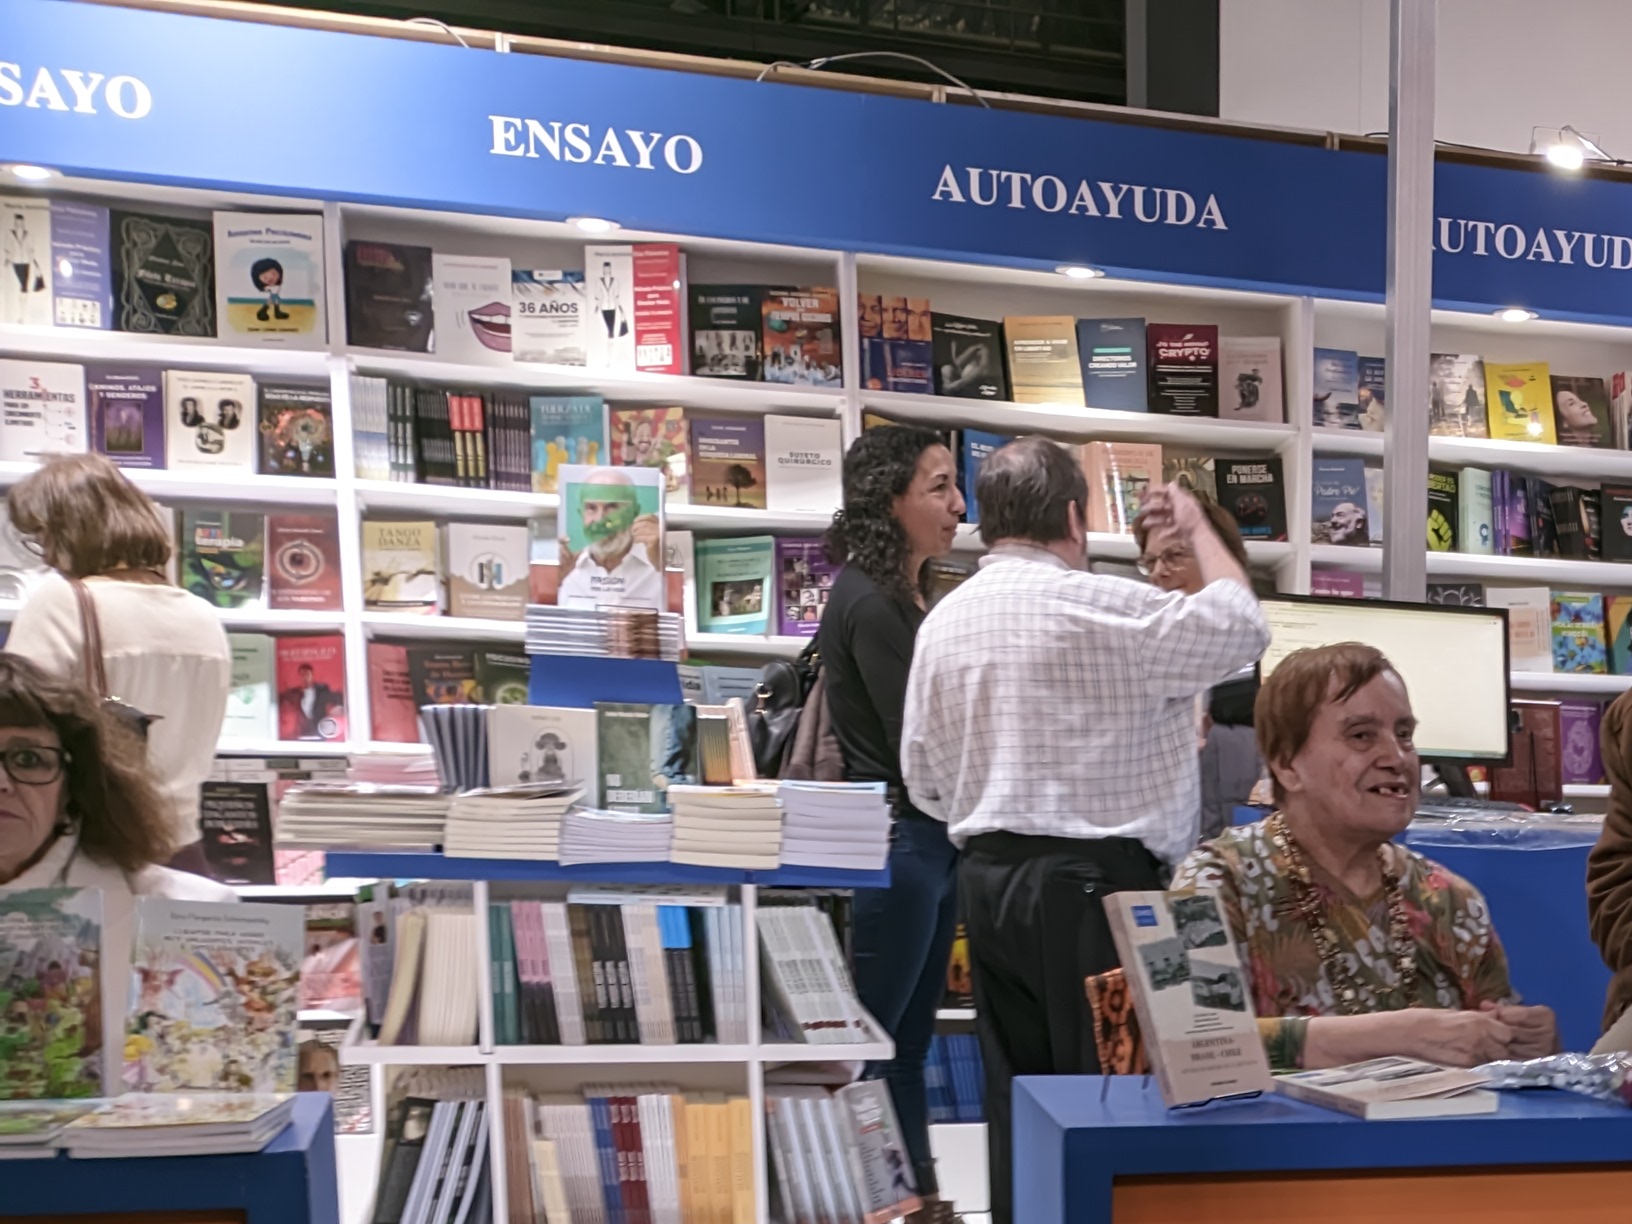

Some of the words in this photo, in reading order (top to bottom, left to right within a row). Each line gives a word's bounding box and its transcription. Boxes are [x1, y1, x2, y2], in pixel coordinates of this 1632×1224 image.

[487, 114, 704, 174] ENSAYO
[932, 165, 1227, 230] AUTOAYUDA
[519, 302, 536, 313] 36
[539, 300, 579, 313] AÑOS
[28, 376, 41, 389] 3
[378, 527, 422, 537] TANGO
[378, 537, 421, 547] DANZA
